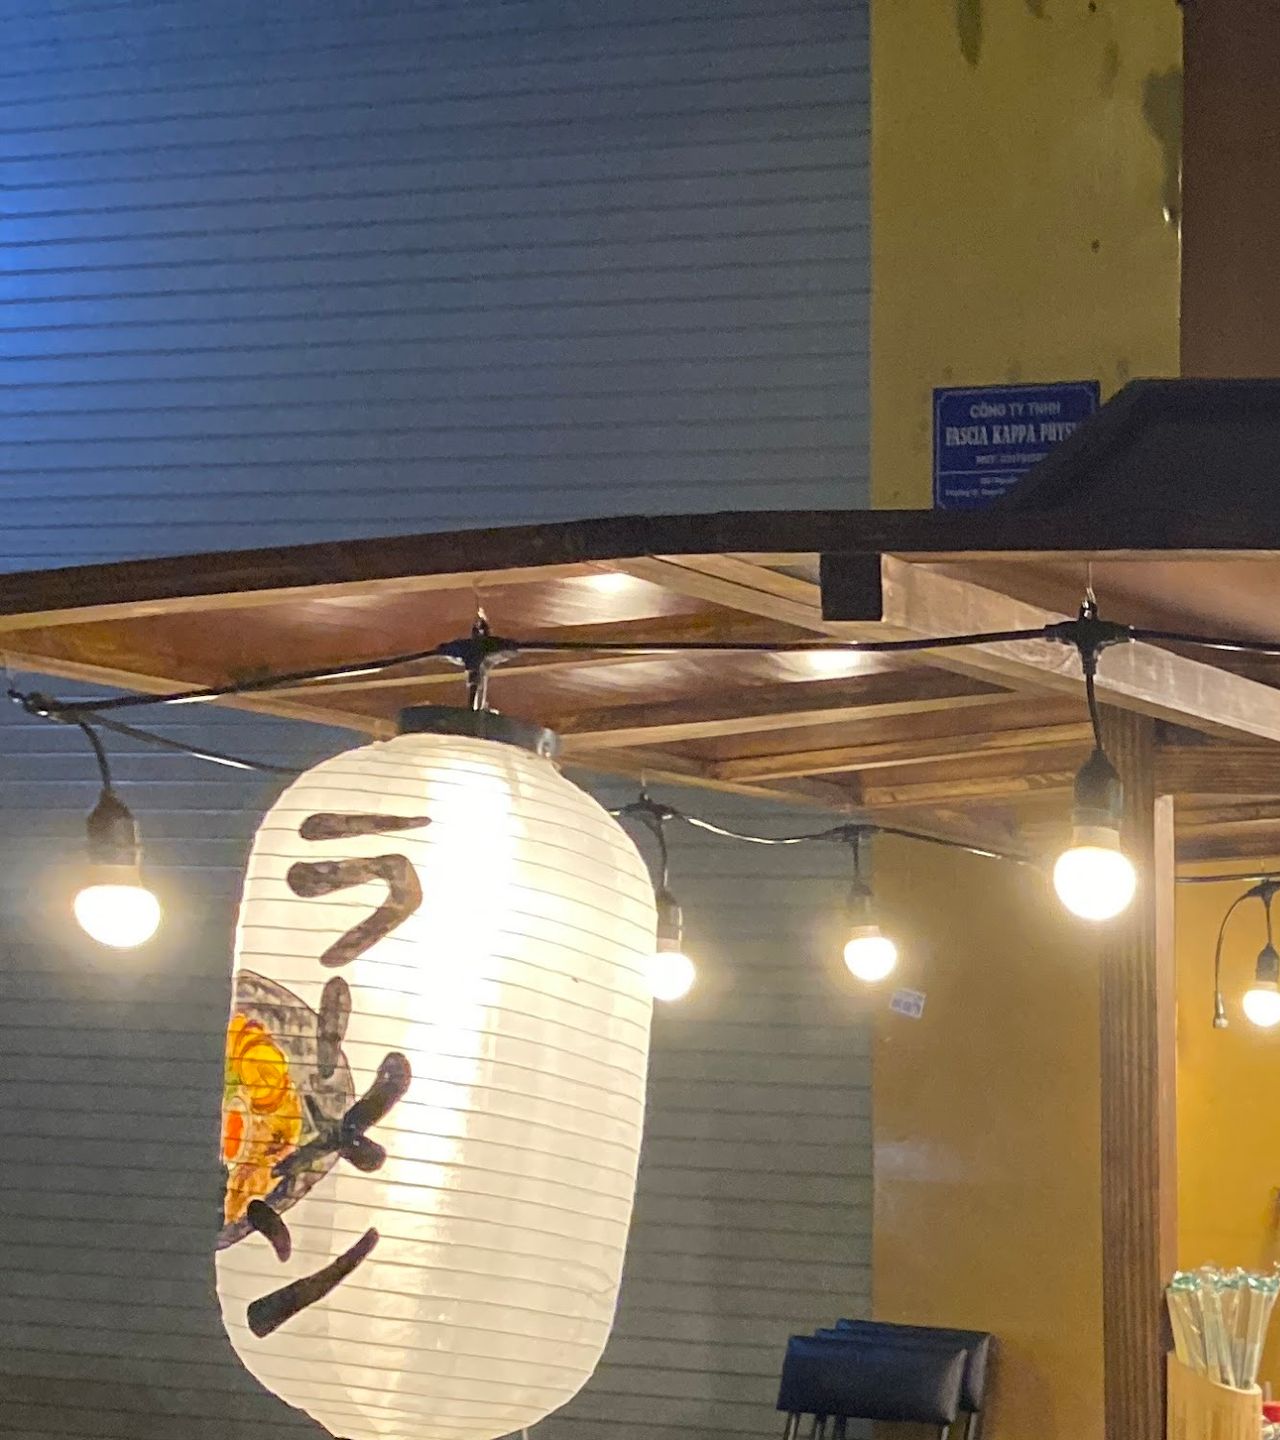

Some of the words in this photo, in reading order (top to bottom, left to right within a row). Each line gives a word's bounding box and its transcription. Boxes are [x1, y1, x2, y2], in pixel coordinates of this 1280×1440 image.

[969, 402, 1006, 419] CÔNG
[1008, 402, 1025, 417] TY
[1027, 401, 1061, 416] TNHH
[992, 424, 1037, 445] KAPPA
